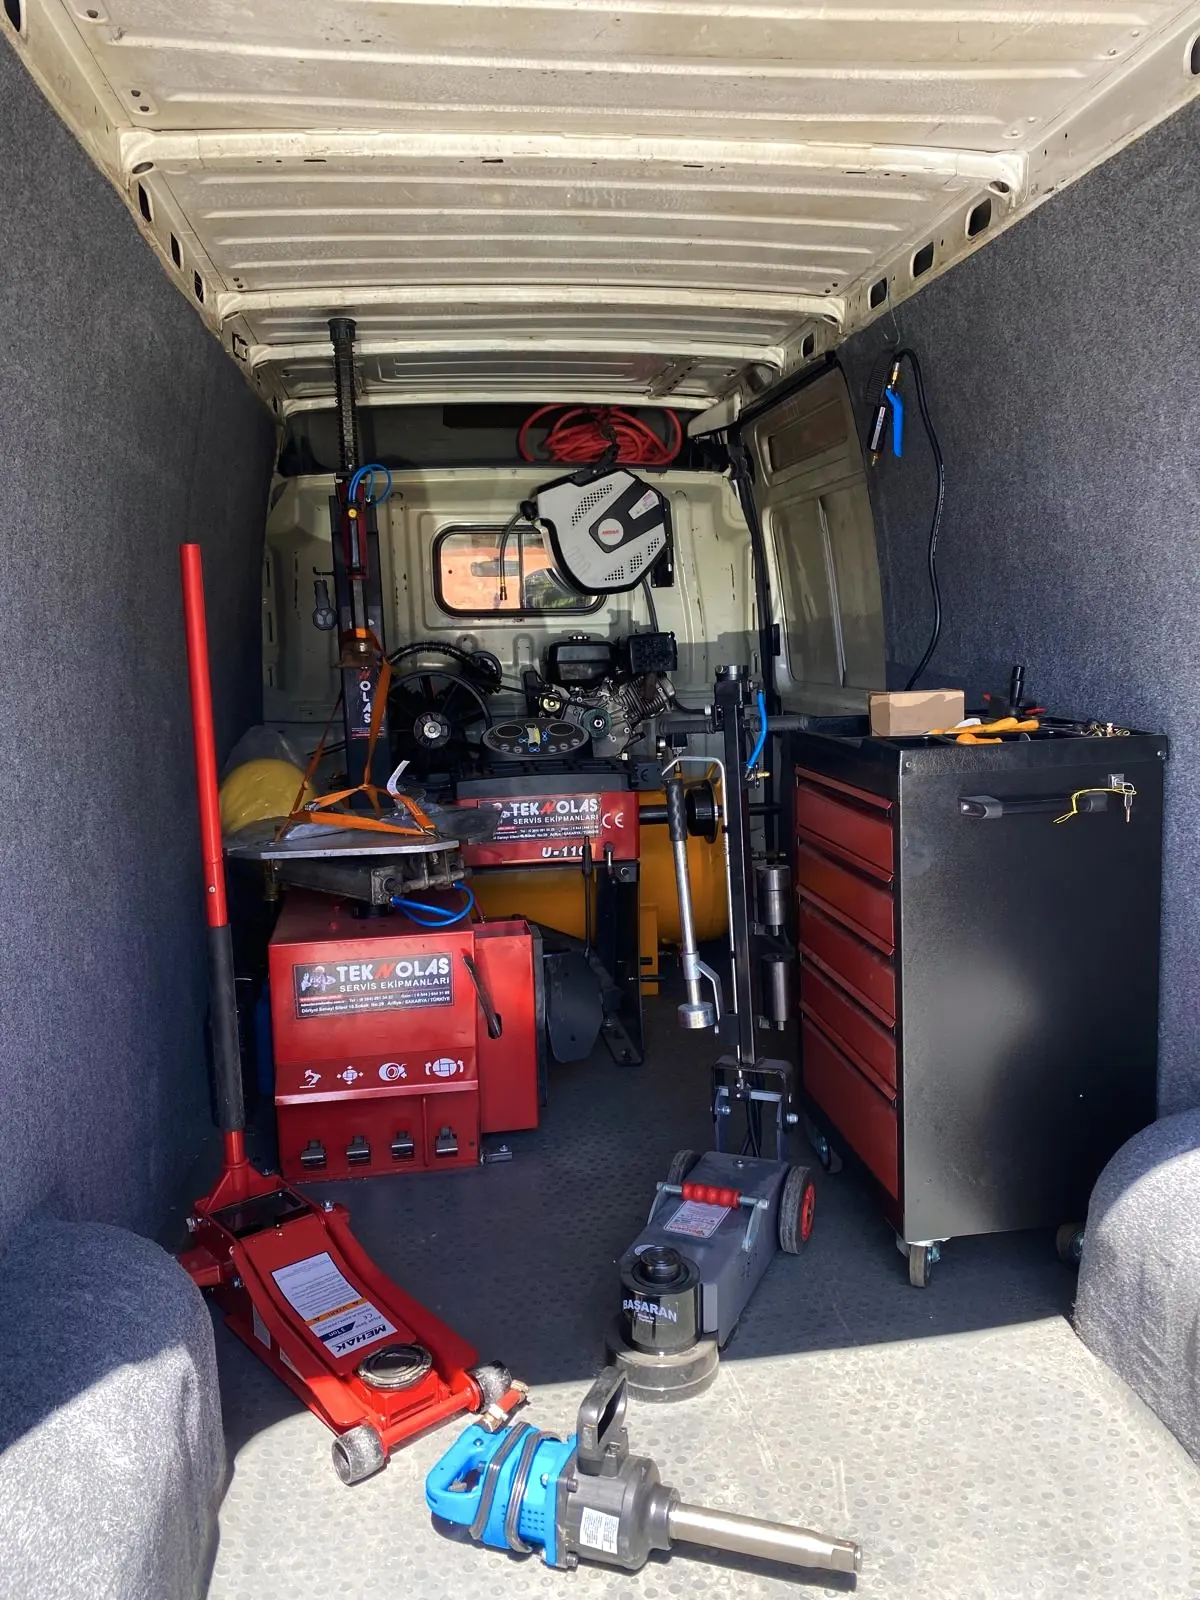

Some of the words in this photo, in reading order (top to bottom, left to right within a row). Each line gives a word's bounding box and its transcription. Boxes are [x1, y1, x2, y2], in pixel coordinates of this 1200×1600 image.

[511, 798, 598, 816] TEKNOLAS
[513, 816, 542, 825] SERVİS
[544, 814, 599, 823] EKİPMANLARI
[336, 957, 450, 982] TEKNOLAS
[339, 981, 377, 993] SERVİS
[380, 977, 450, 989] EKİPMANLARI
[622, 1299, 677, 1323] BAŞARAN
[336, 1324, 387, 1352] MEHAK
